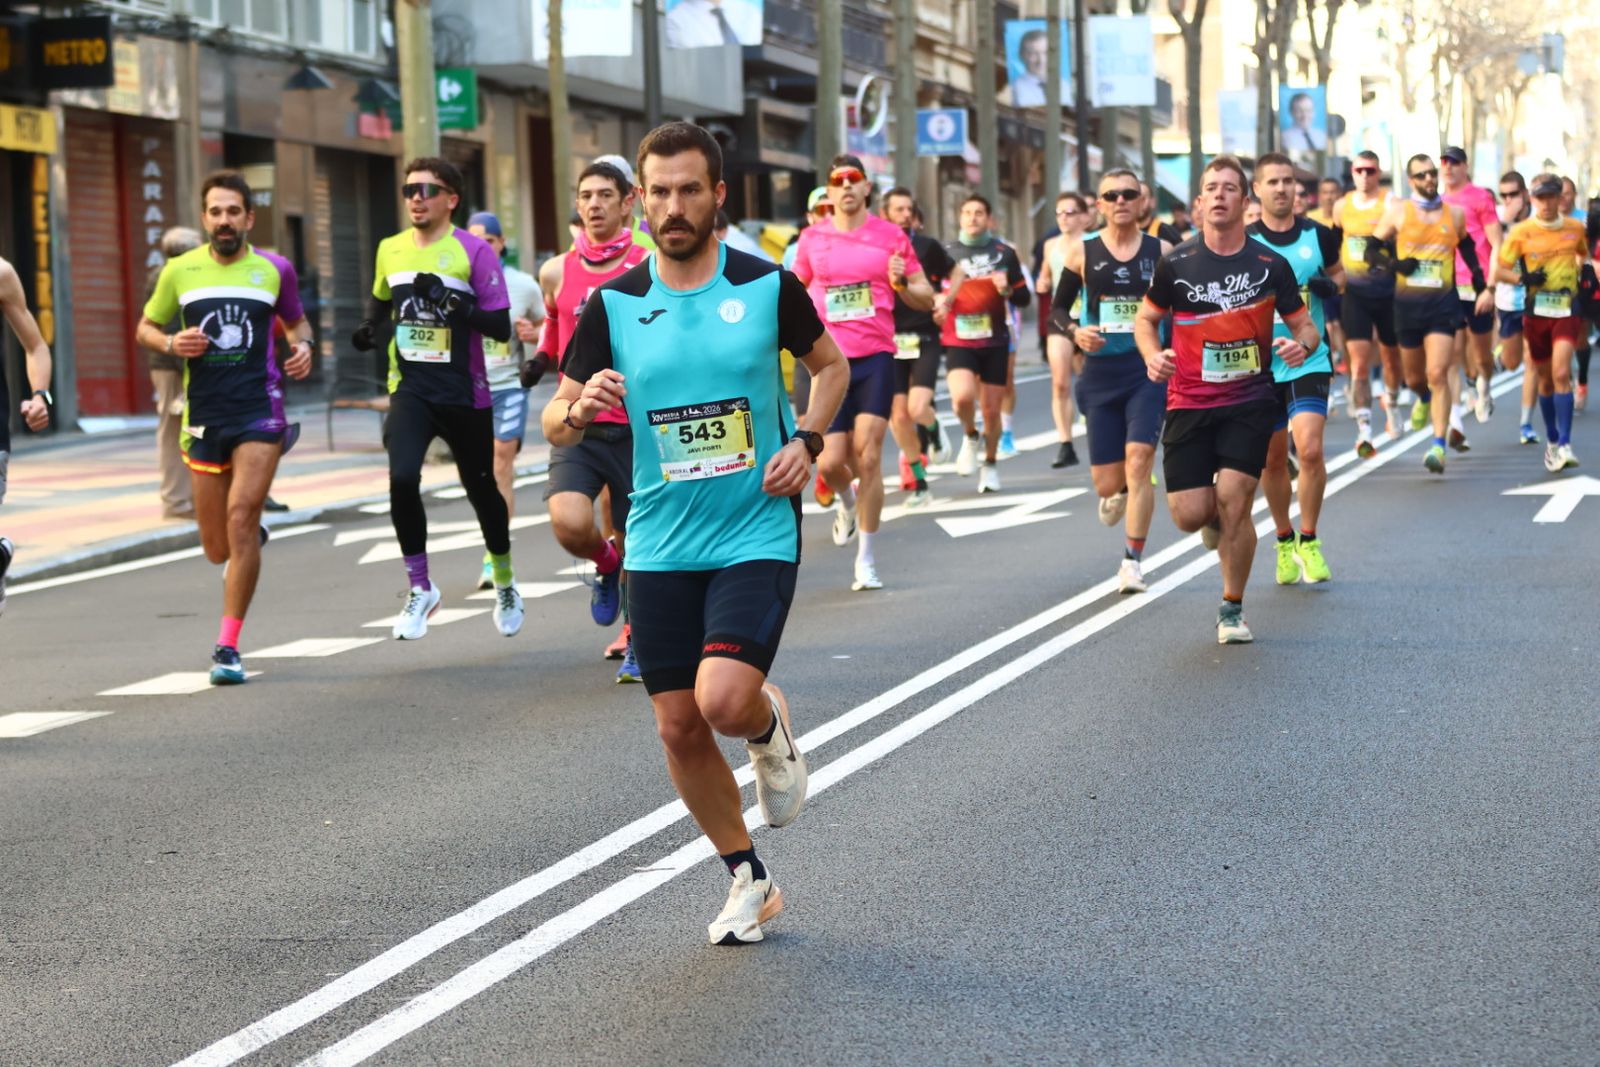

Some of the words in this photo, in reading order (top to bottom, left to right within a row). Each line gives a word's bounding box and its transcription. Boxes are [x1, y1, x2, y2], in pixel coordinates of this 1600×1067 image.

[44, 38, 107, 65] METRO
[143, 138, 165, 268] PARAFA
[834, 291, 862, 304] 2127
[1114, 304, 1138, 314] 539
[409, 329, 435, 341] 202
[1214, 350, 1250, 363] 1194
[702, 405, 721, 414] 2026
[679, 420, 726, 444] 543
[702, 444, 722, 452] PORTI
